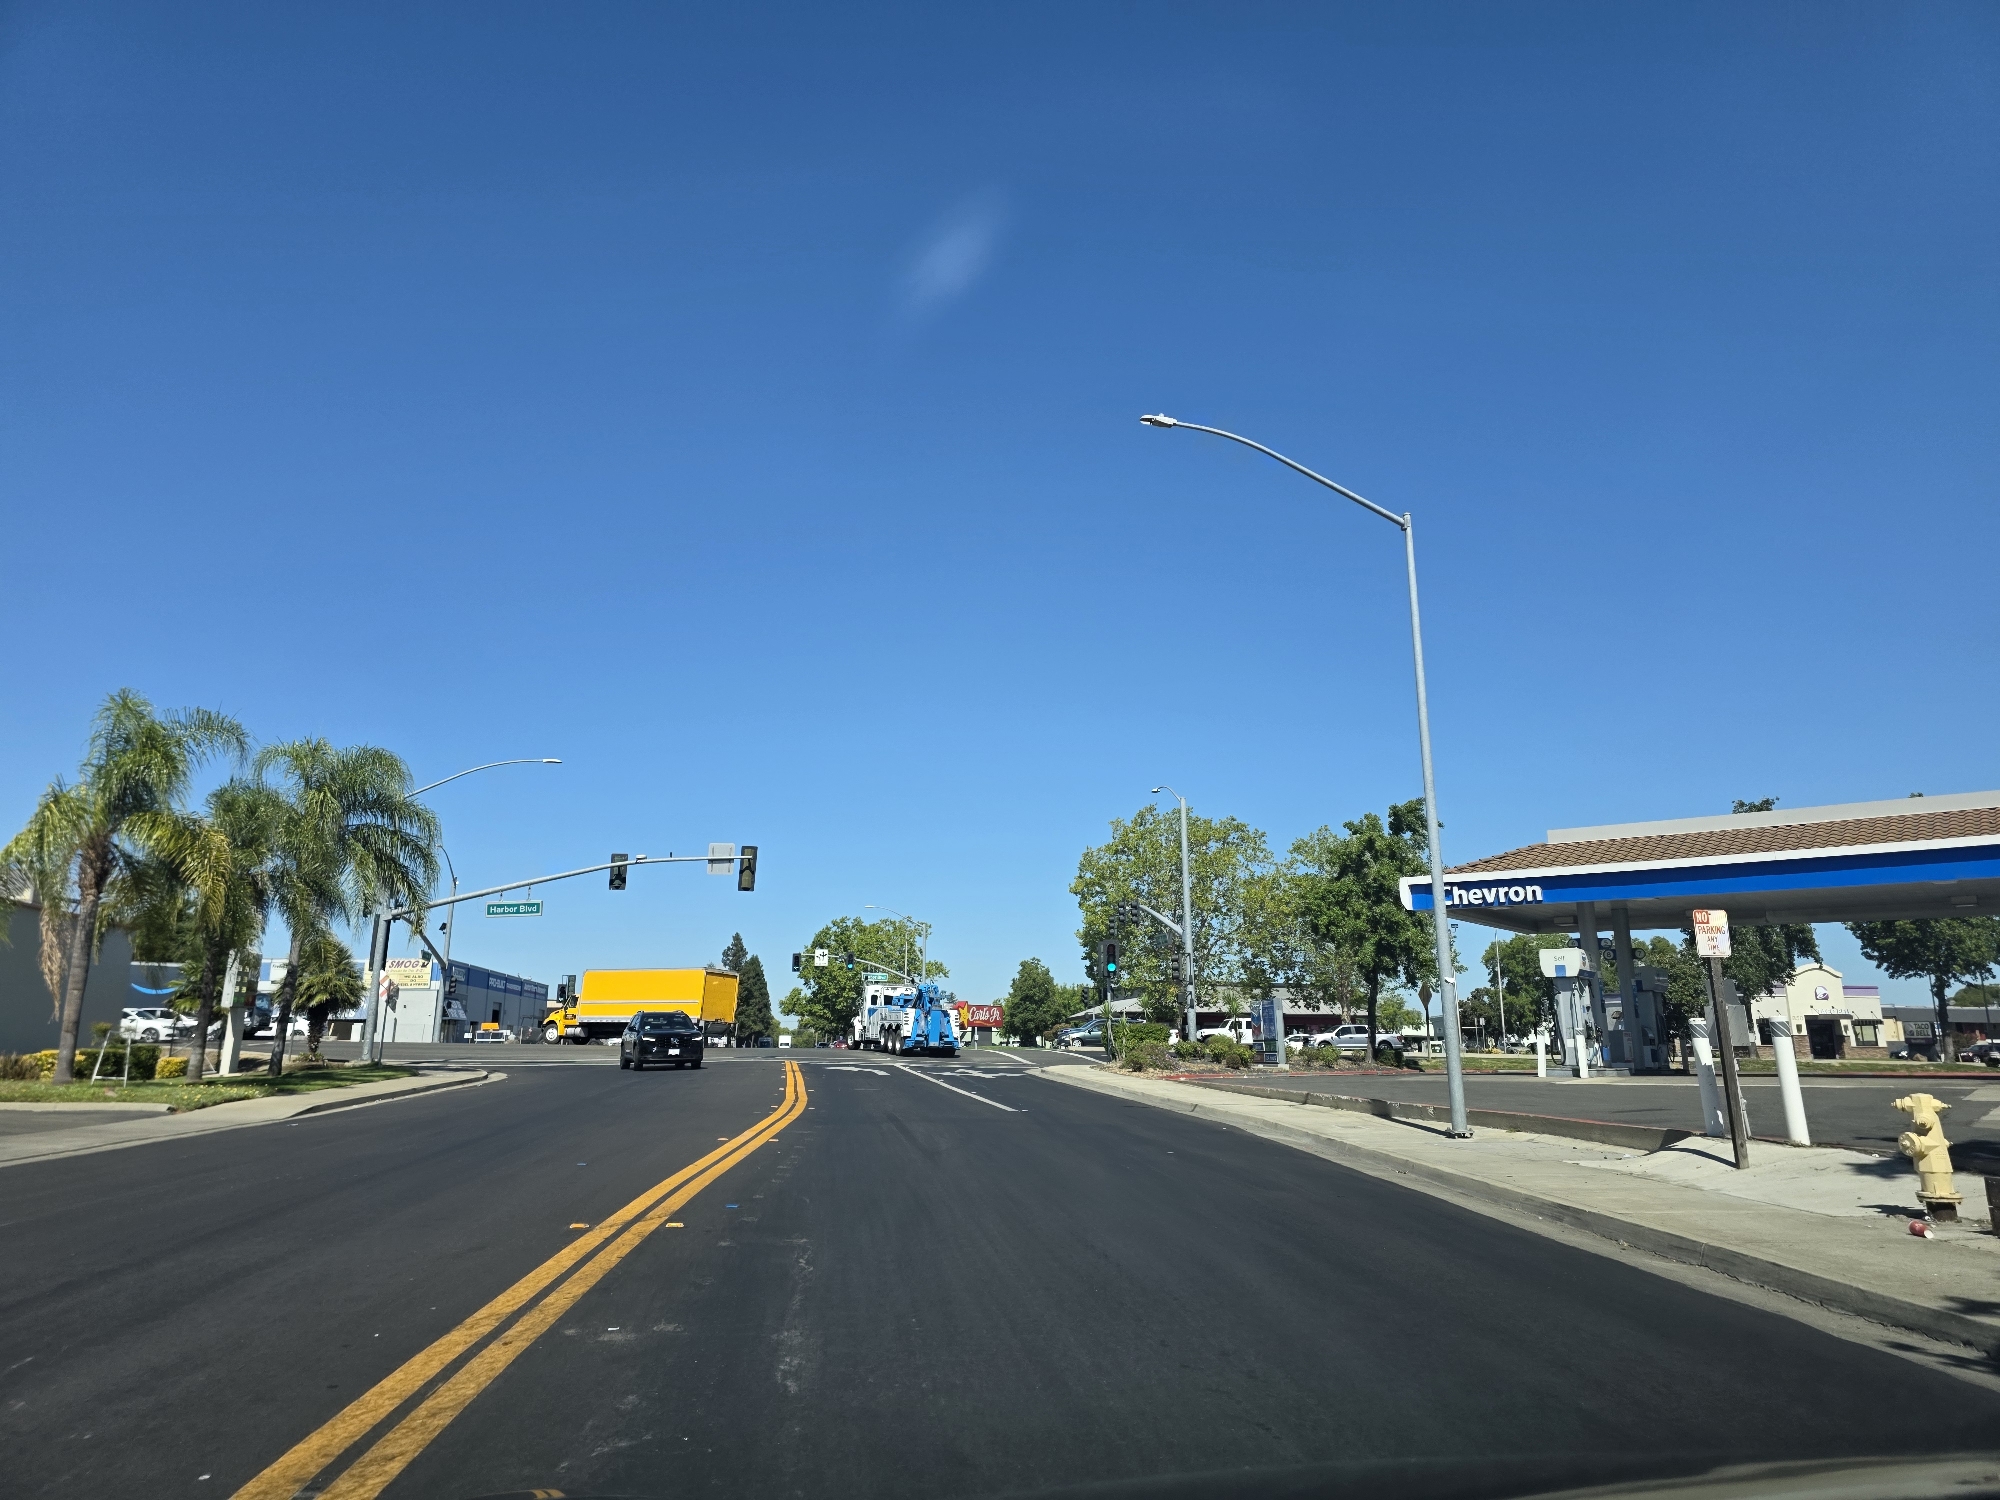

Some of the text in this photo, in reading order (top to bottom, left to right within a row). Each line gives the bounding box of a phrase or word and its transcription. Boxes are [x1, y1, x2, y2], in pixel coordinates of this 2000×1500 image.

[490, 905, 517, 913] Harbor
[1696, 911, 1708, 922] NO
[1698, 926, 1725, 934] PARKING
[389, 960, 420, 968] SMOG
[969, 1007, 1001, 1022] Carl's Jr.
